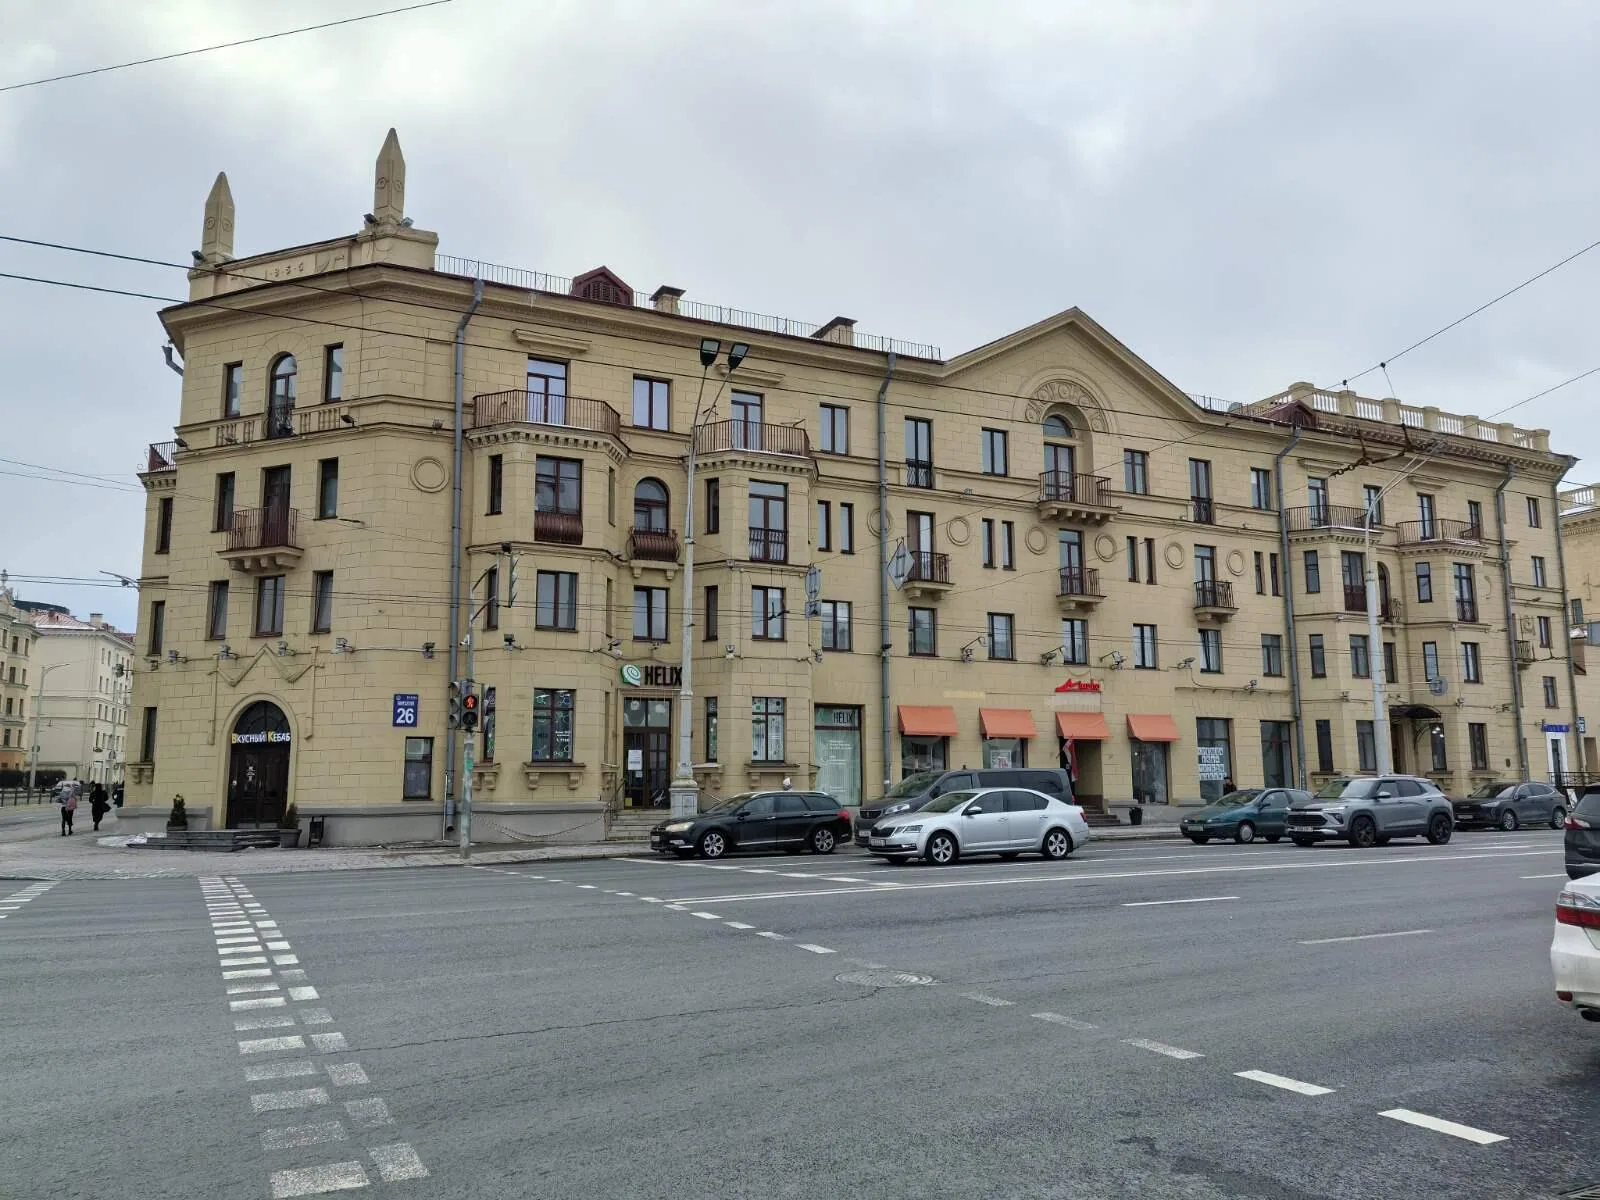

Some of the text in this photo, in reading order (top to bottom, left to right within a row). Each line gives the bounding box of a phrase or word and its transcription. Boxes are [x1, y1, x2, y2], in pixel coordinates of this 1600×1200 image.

[644, 665, 682, 686] HELIX
[396, 707, 414, 724] 26
[833, 711, 853, 724] HELIX
[267, 731, 290, 743] КЕБАБ
